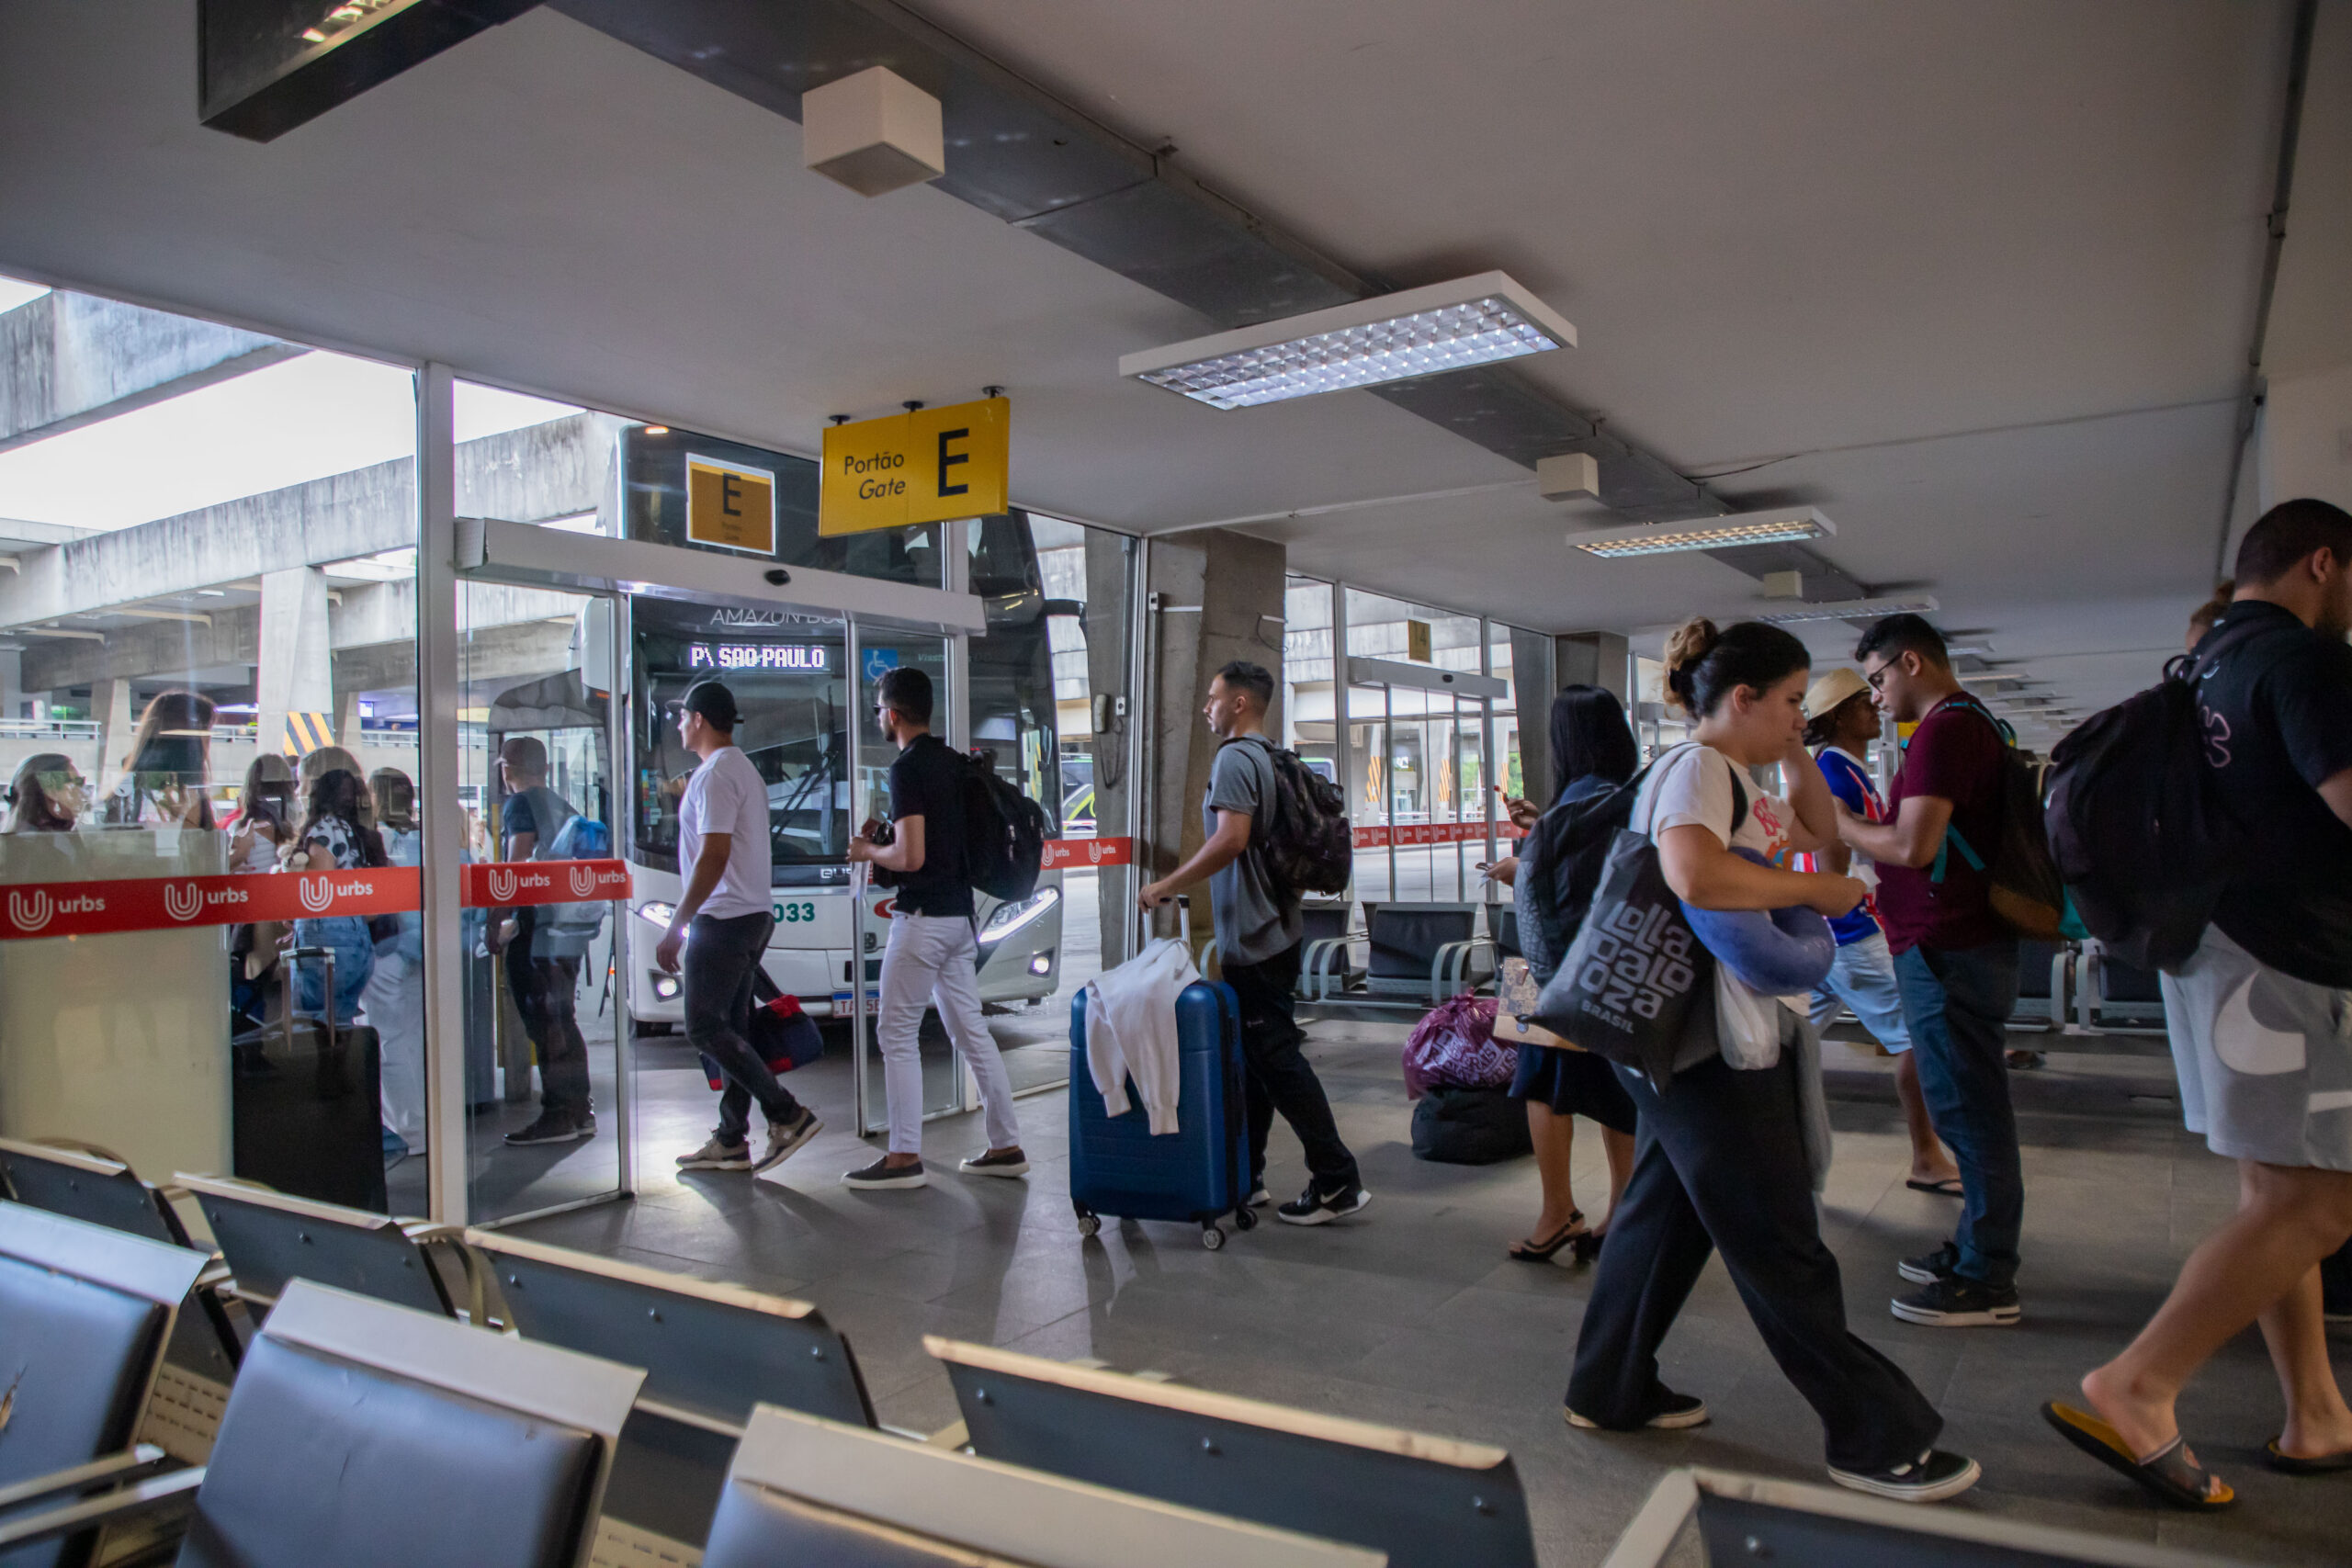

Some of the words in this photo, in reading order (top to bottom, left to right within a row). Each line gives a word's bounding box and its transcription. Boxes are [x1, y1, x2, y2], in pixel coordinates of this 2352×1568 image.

[844, 451, 905, 476] Portão
[938, 428, 969, 497] E
[722, 472, 741, 517] E
[859, 478, 906, 500] Gate
[762, 647, 825, 668] PAULO
[519, 874, 551, 887] urbs
[598, 870, 627, 884] urbs
[207, 887, 249, 905] urbs
[336, 881, 374, 897] urbs
[58, 895, 106, 913] urbs
[1580, 998, 1634, 1034] BRASIL
